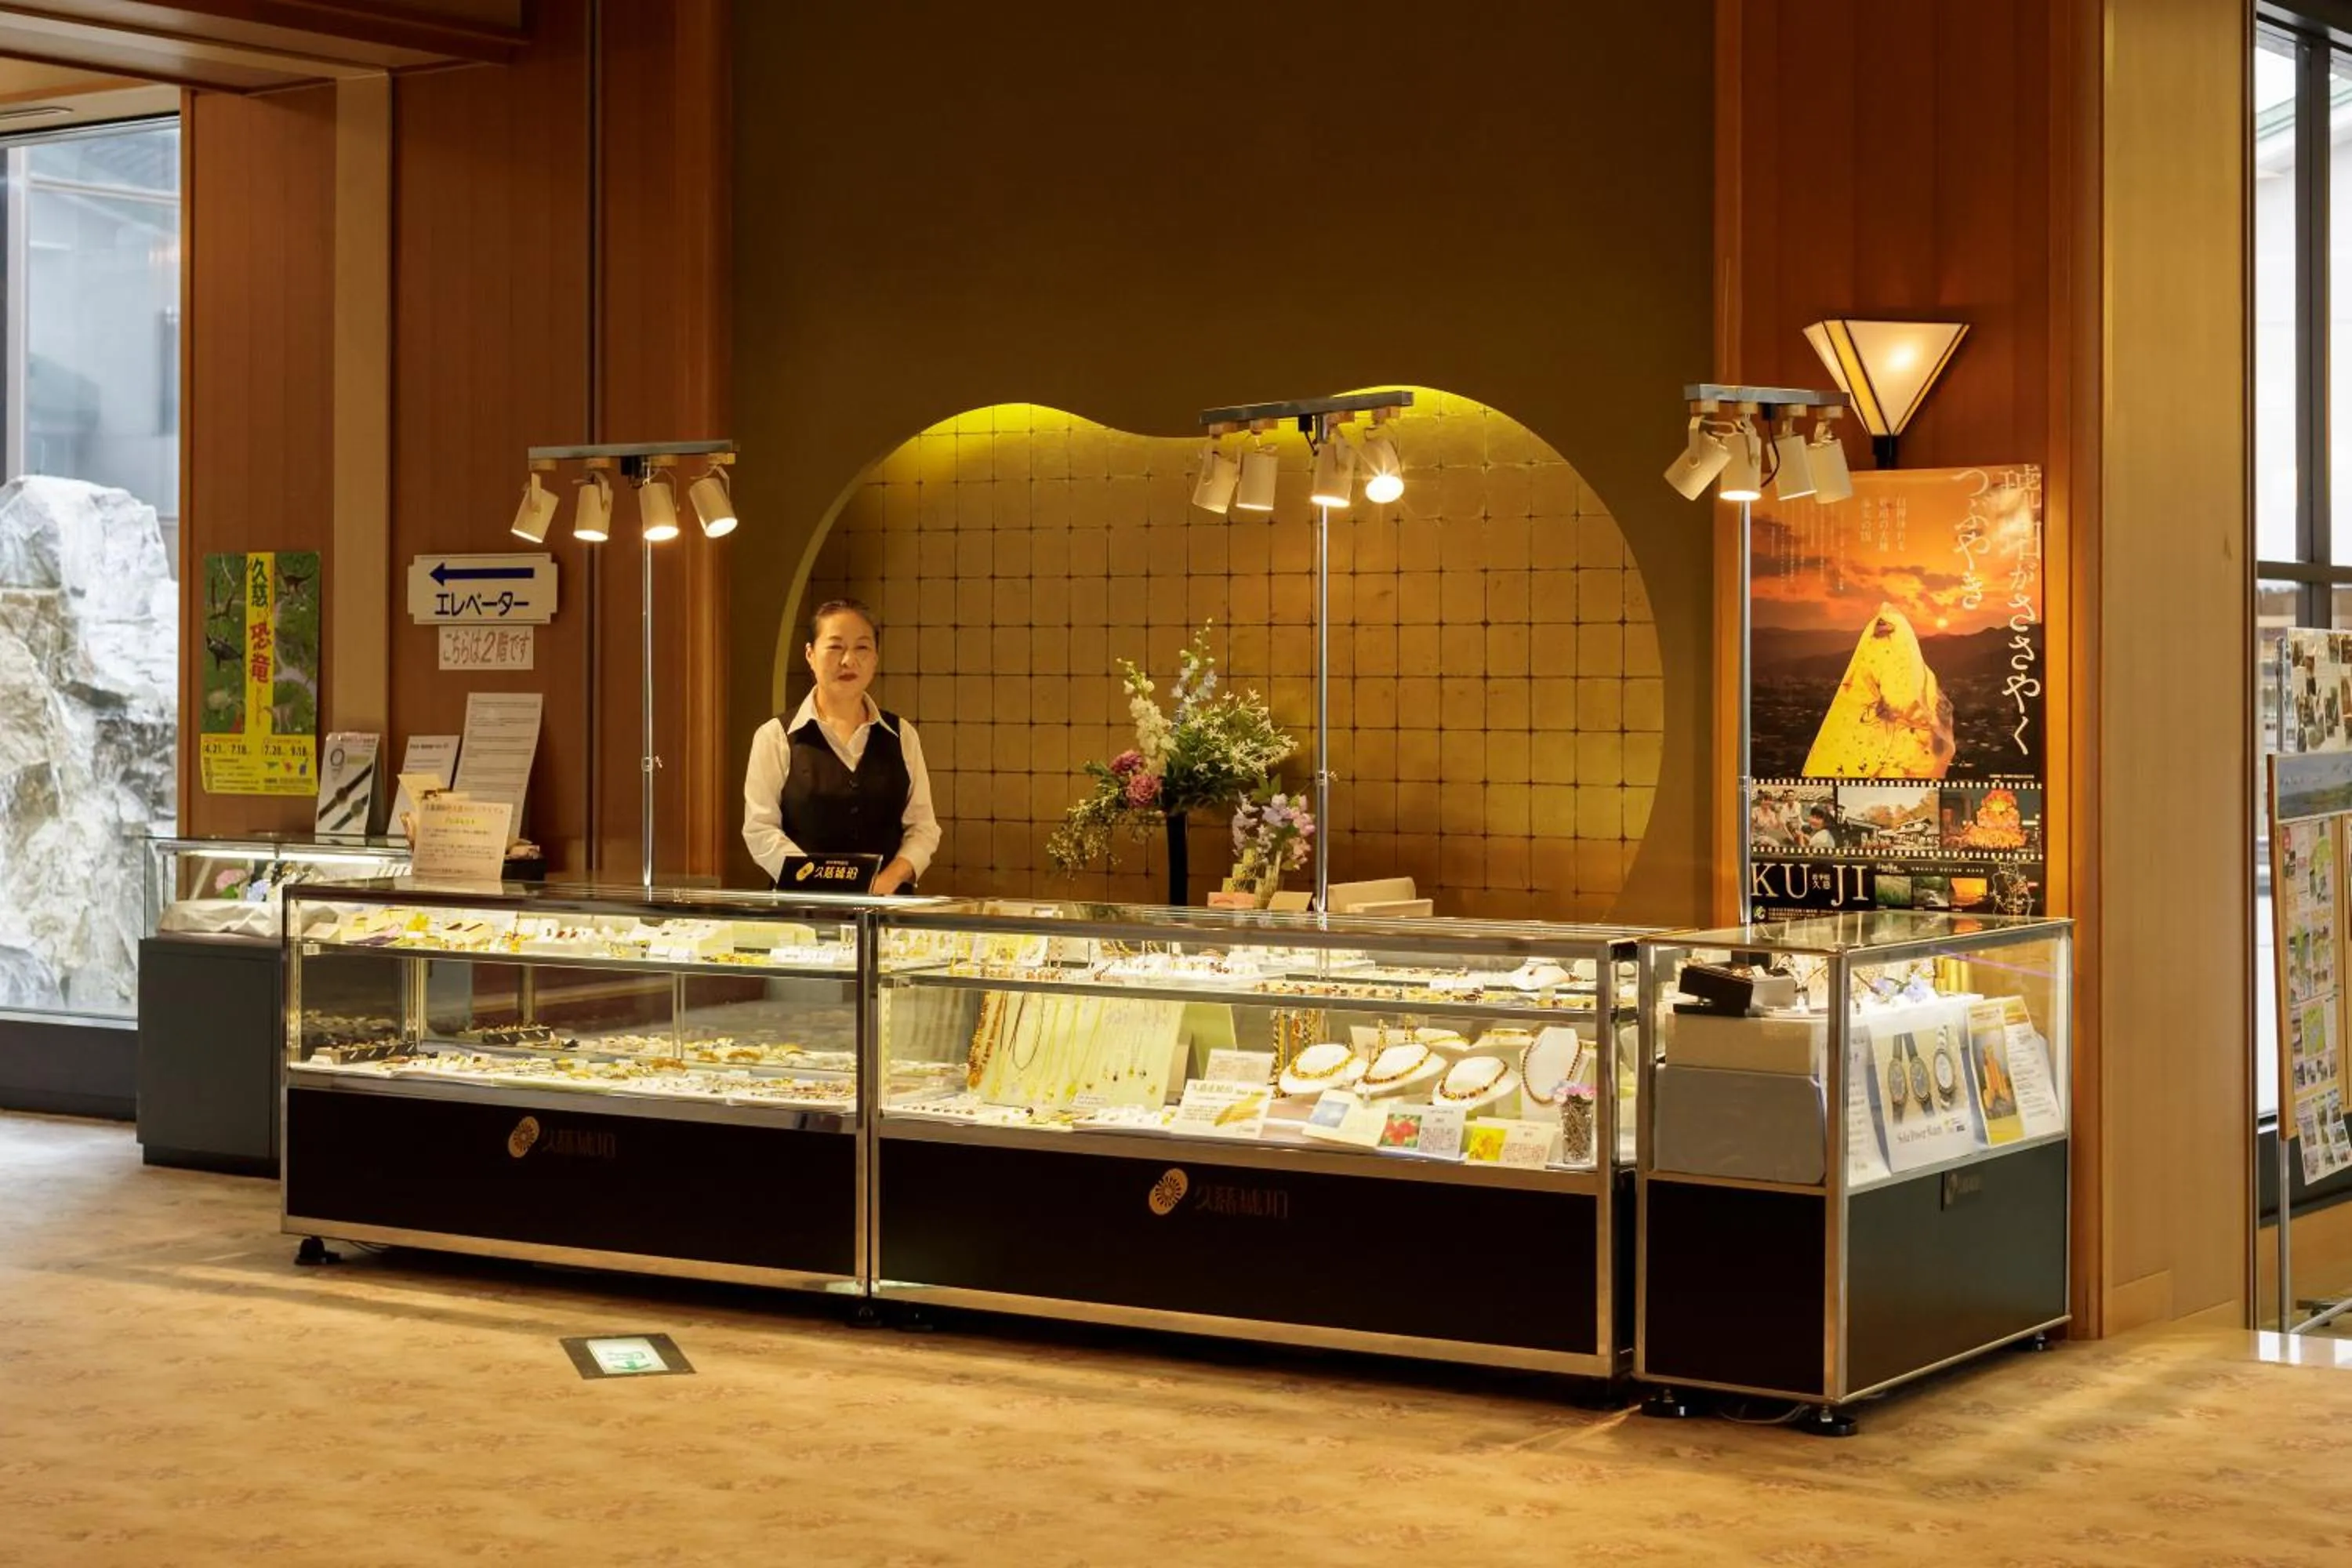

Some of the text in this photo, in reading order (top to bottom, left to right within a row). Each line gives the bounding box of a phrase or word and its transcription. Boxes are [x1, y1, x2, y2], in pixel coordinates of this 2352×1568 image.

[434, 591, 530, 617] エレベーター
[443, 628, 531, 664] こちらは2階です
